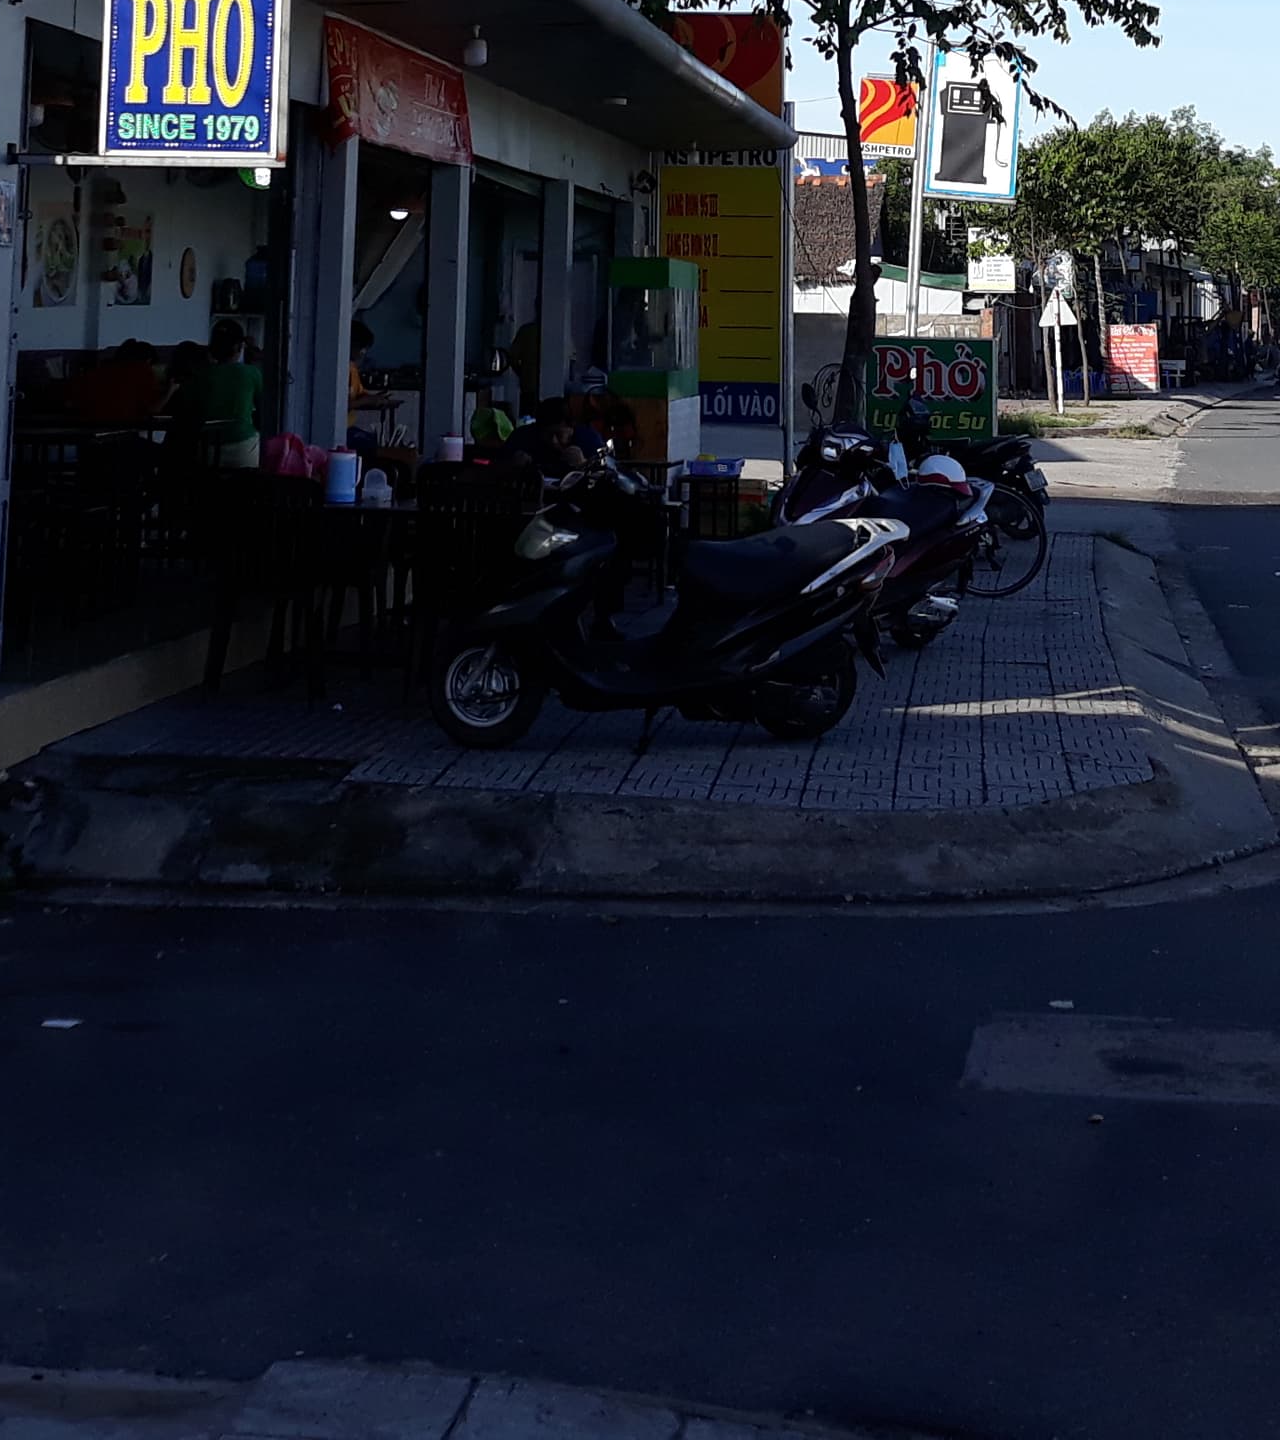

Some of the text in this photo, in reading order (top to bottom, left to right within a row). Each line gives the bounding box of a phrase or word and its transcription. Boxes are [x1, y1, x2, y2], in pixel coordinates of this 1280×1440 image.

[118, 112, 260, 141] SINCE 1979
[872, 342, 986, 399] Phở
[703, 385, 776, 417] LỐI VÀO
